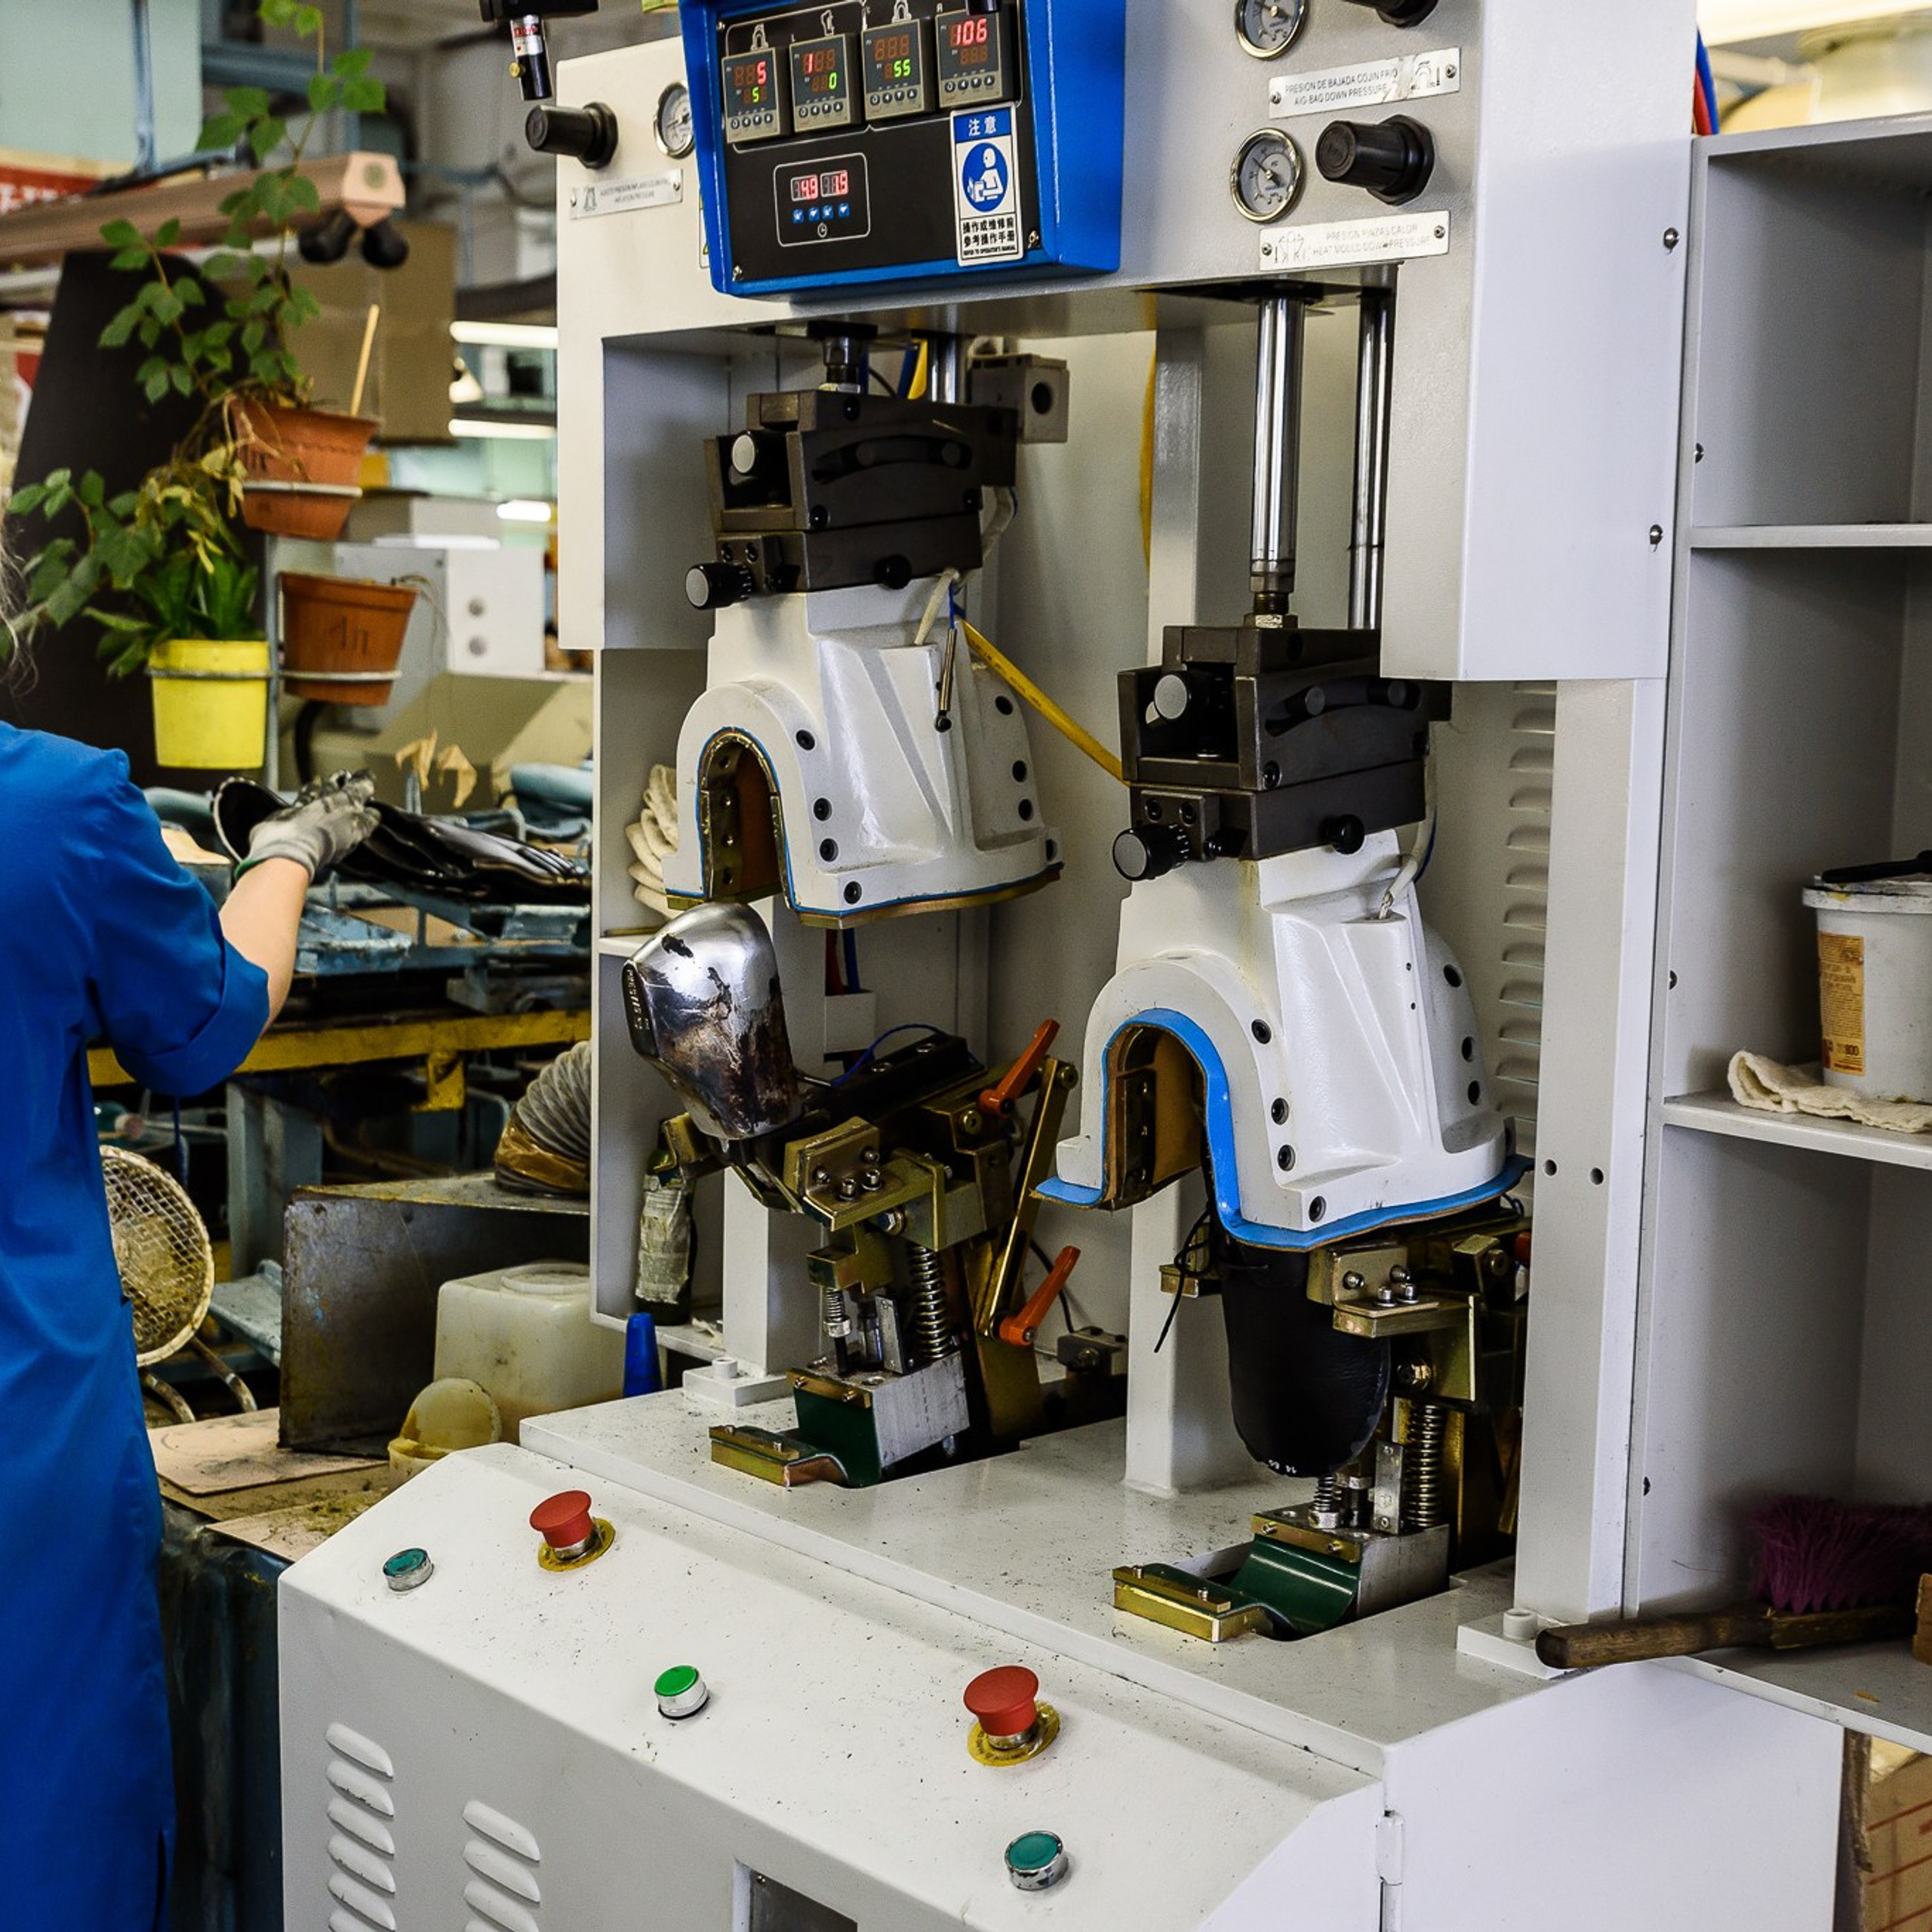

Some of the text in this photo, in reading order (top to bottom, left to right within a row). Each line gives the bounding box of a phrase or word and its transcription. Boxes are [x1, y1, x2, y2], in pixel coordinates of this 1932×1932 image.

[955, 18, 988, 46] 106
[756, 60, 767, 85] 5
[894, 59, 910, 78] 55
[829, 72, 837, 89] 0
[1317, 78, 1327, 90] DE
[1328, 74, 1355, 88] BAJADA
[752, 86, 760, 103] 5
[1324, 90, 1347, 102] DOWN
[968, 115, 996, 137] 注意
